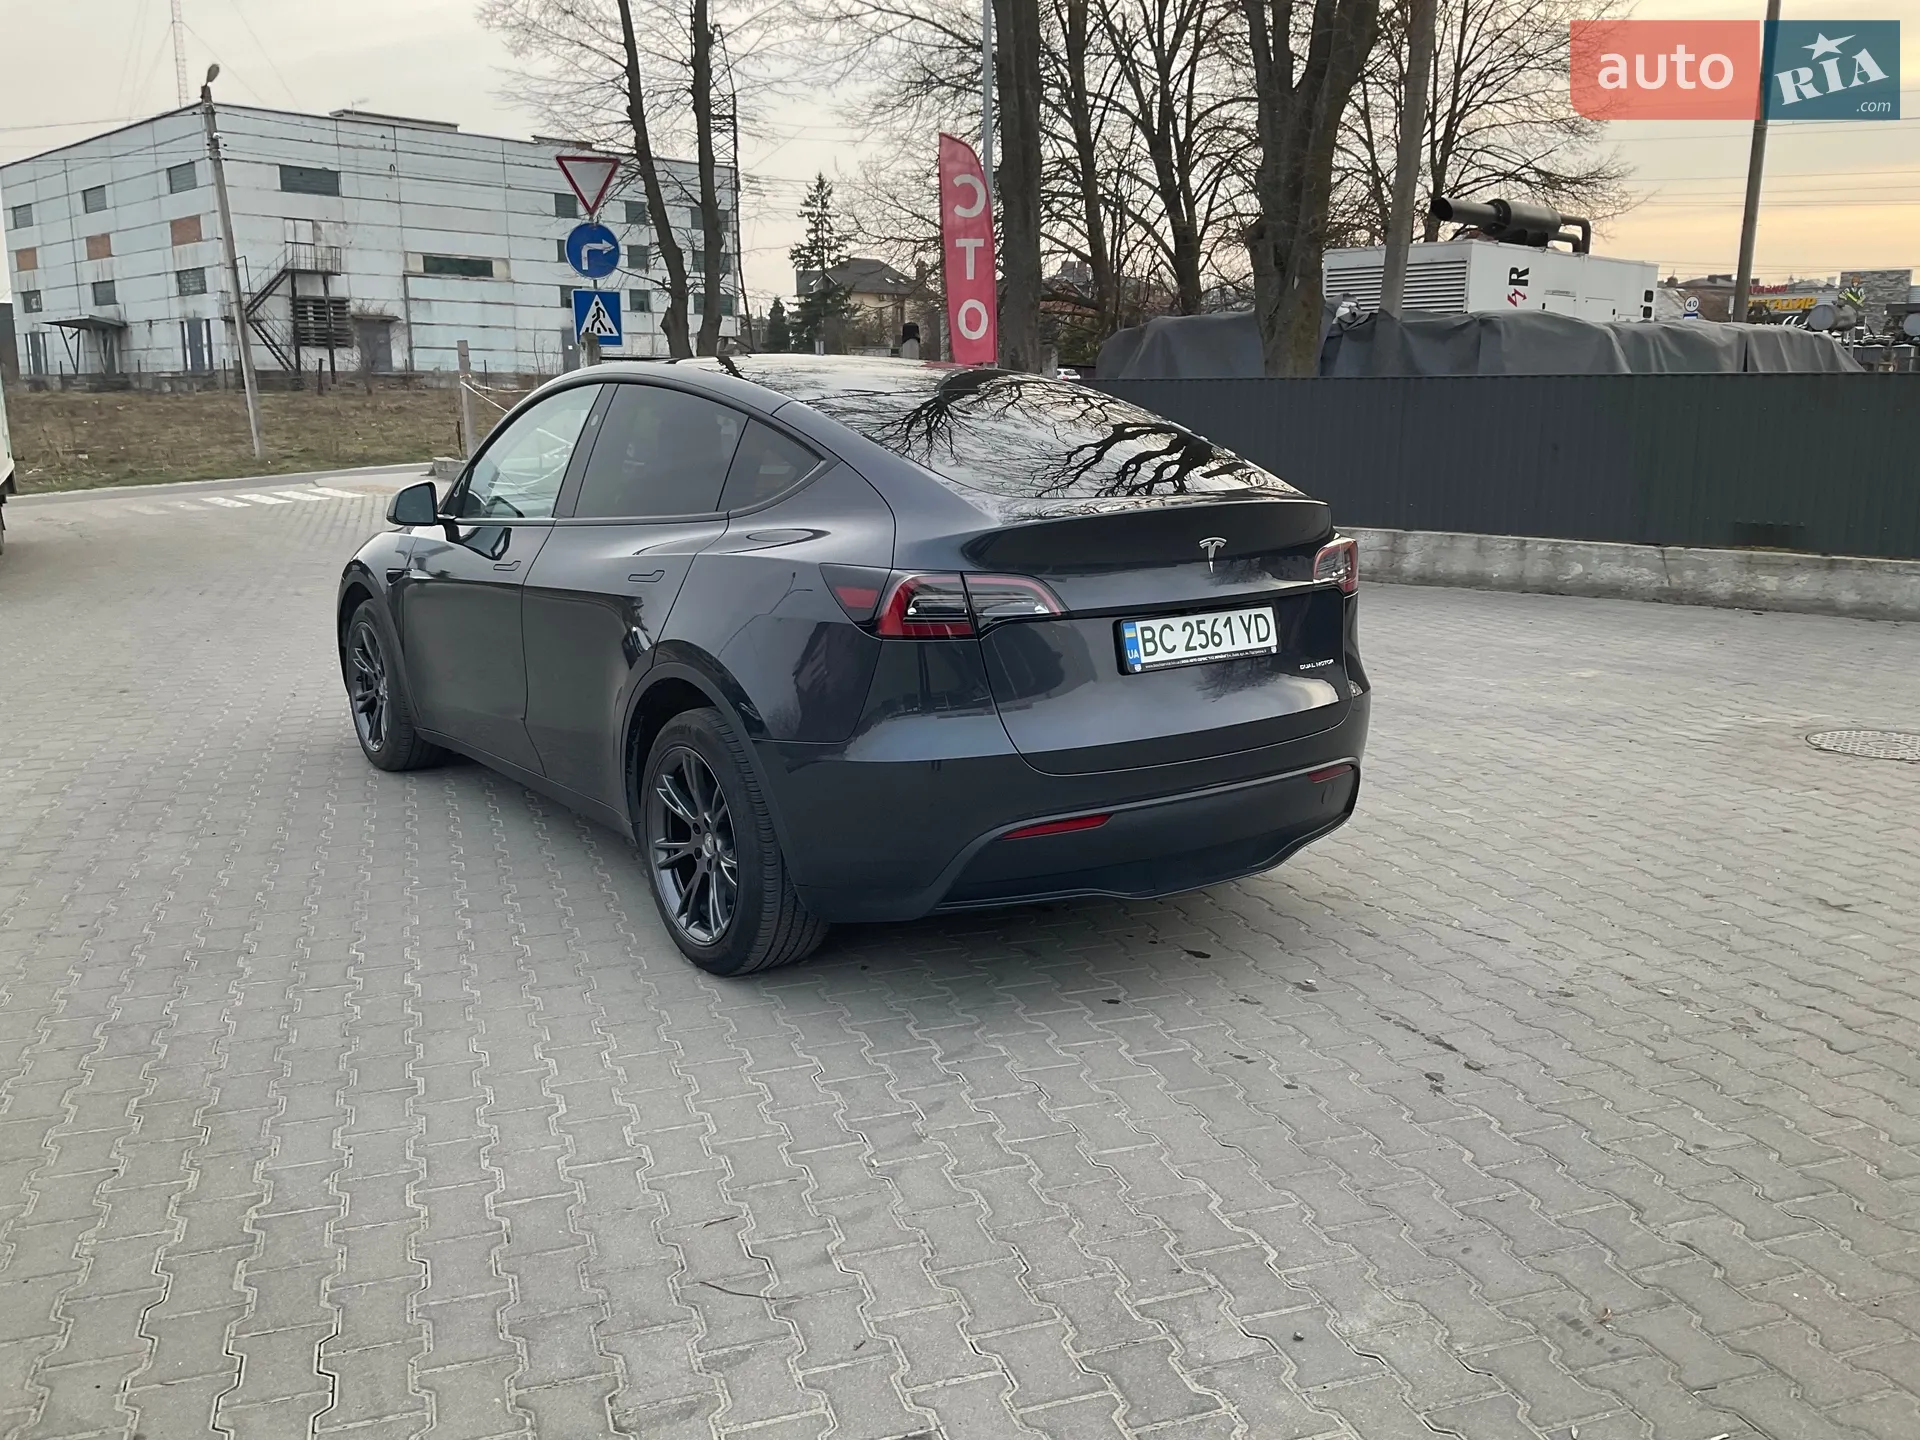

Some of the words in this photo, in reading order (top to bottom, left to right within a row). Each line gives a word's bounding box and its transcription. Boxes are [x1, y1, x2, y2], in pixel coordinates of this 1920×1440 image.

[1686, 300, 1698, 308] 40
[1140, 623, 1177, 657] BC
[1181, 616, 1236, 653] 2561
[1239, 613, 1271, 644] YD
[1127, 649, 1140, 659] UA
[1299, 662, 1316, 670] DUAL
[1316, 658, 1335, 668] MOTOR
